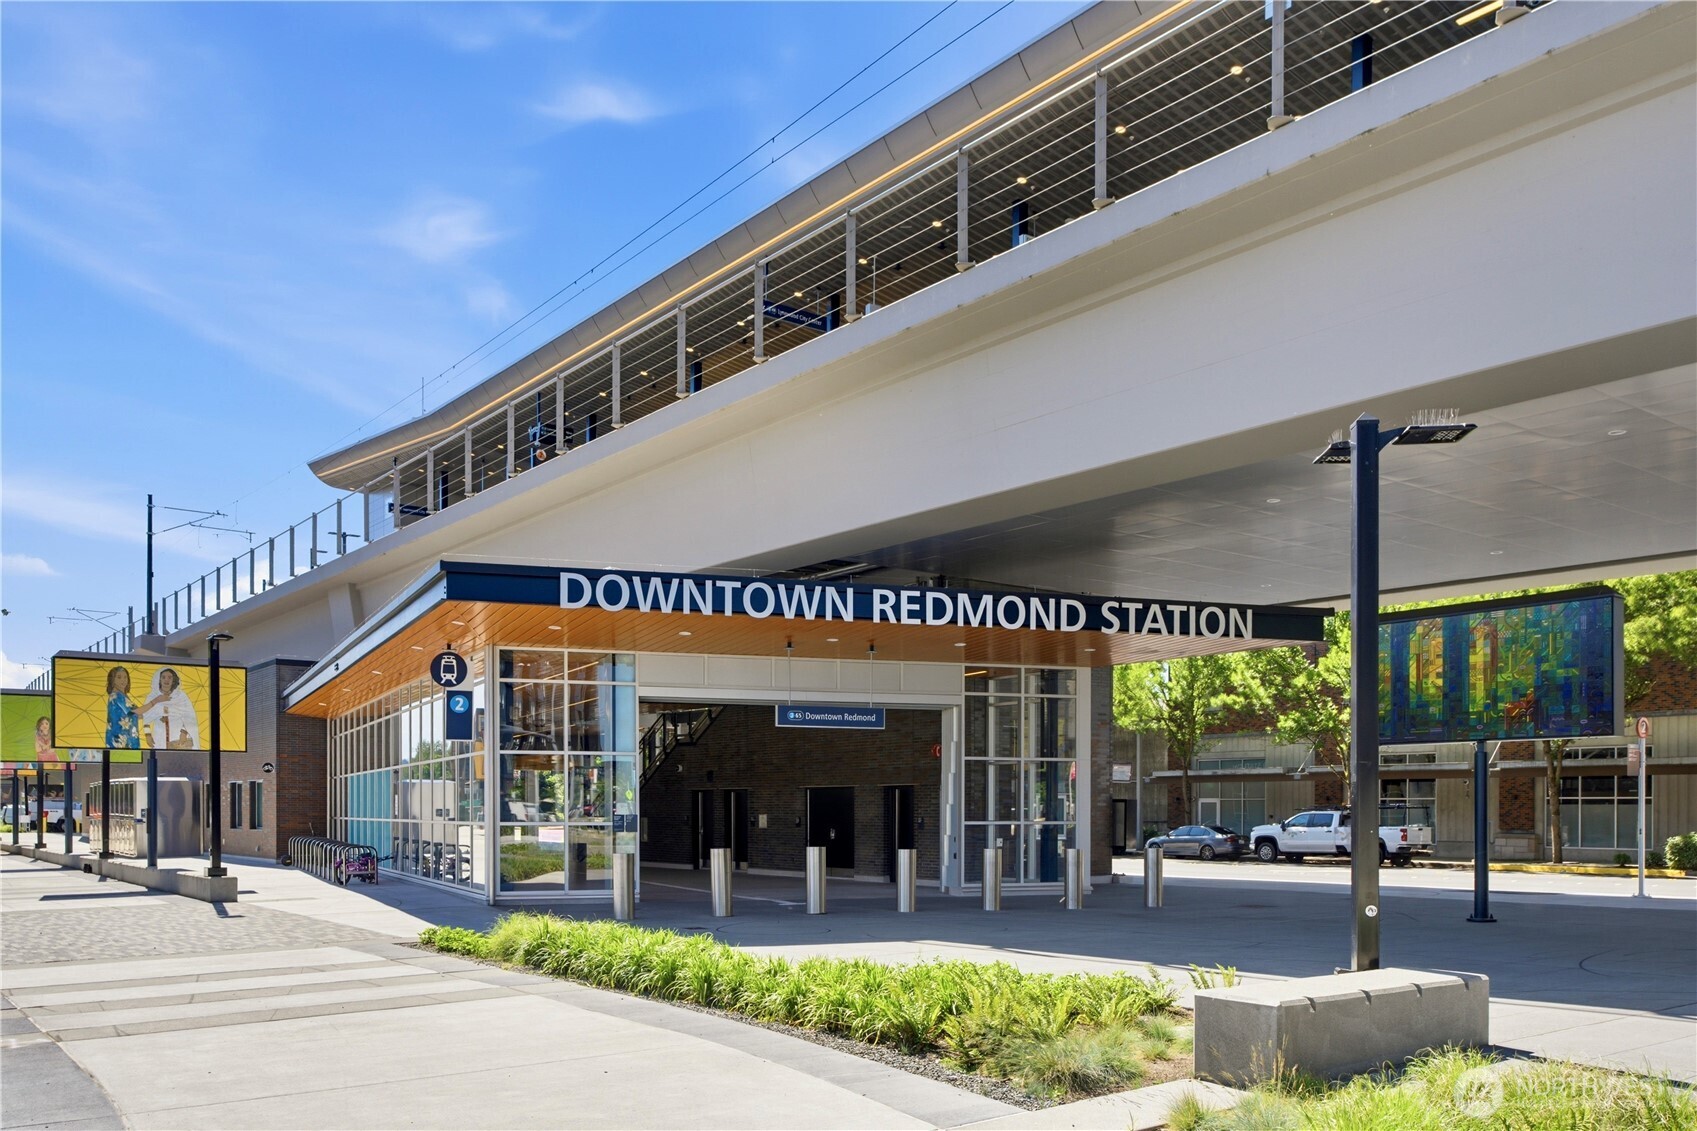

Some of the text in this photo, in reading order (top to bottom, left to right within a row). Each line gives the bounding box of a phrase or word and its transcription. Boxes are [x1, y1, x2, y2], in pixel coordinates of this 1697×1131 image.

[559, 571, 1253, 640] DOWNTOWN REDMOND STATION
[455, 697, 464, 711] 2
[805, 712, 842, 720] Downtown
[844, 713, 876, 721] Redmond
